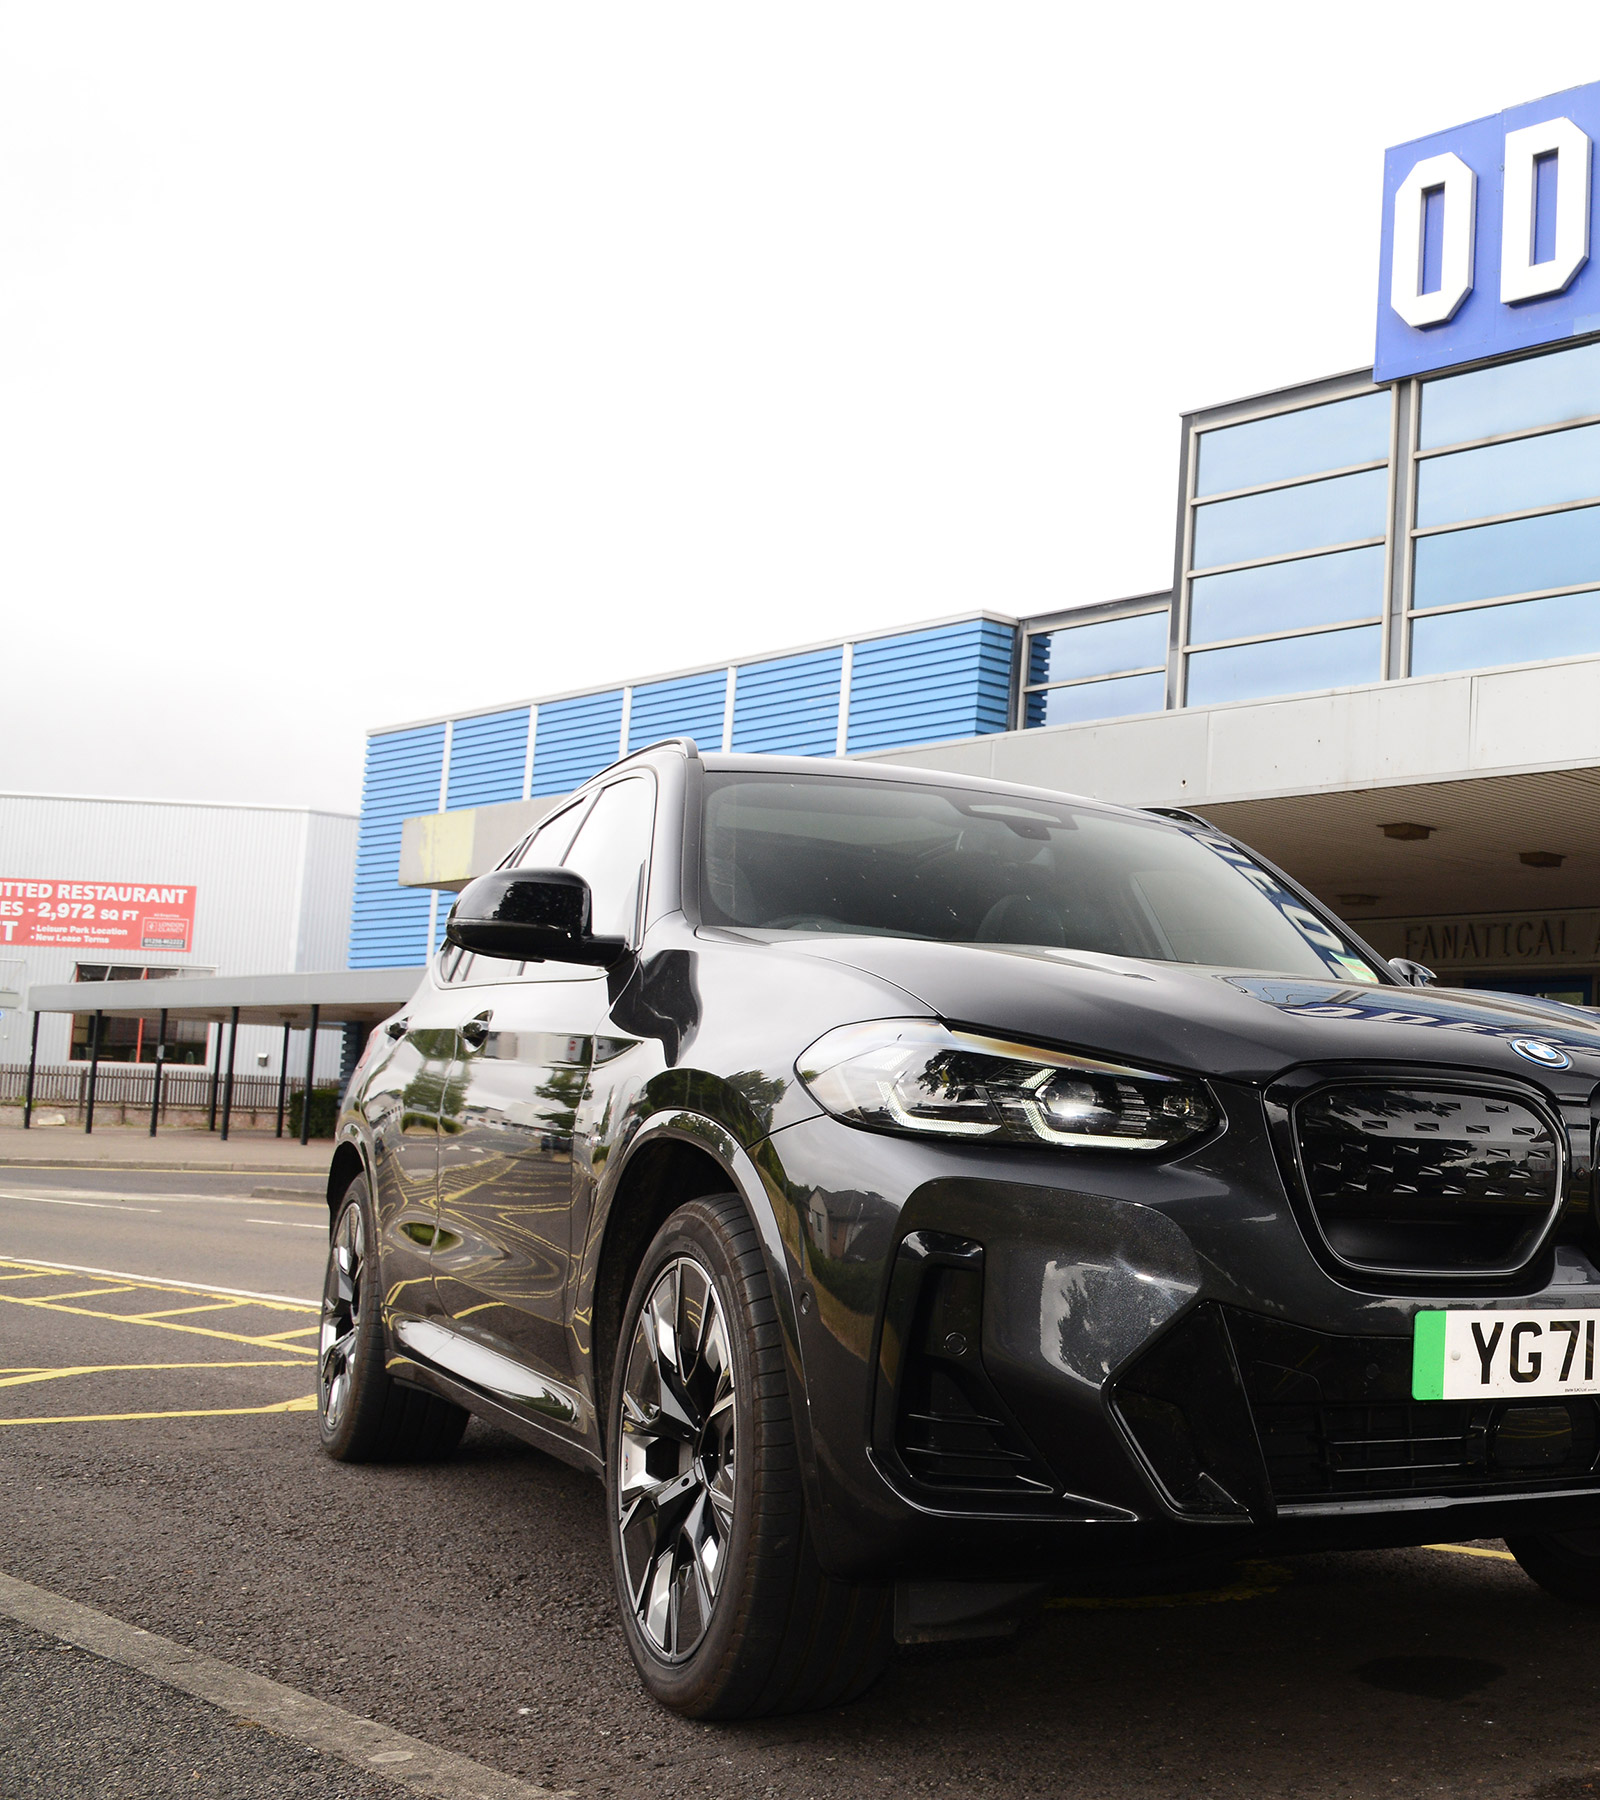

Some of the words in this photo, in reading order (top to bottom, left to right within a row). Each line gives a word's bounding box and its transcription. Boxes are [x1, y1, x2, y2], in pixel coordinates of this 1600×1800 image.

[57, 884, 188, 904] RESTAURANT
[37, 902, 95, 921] 2,972
[100, 909, 119, 920] SQ
[122, 910, 139, 921] FT
[35, 933, 55, 941] New
[56, 934, 82, 942] Lease
[83, 935, 110, 943] Terms
[36, 925, 68, 933] Leisure
[70, 926, 89, 934] Park
[91, 927, 128, 936] Location
[1403, 919, 1573, 961] FANATICAL
[1471, 1320, 1595, 1385] YG71
